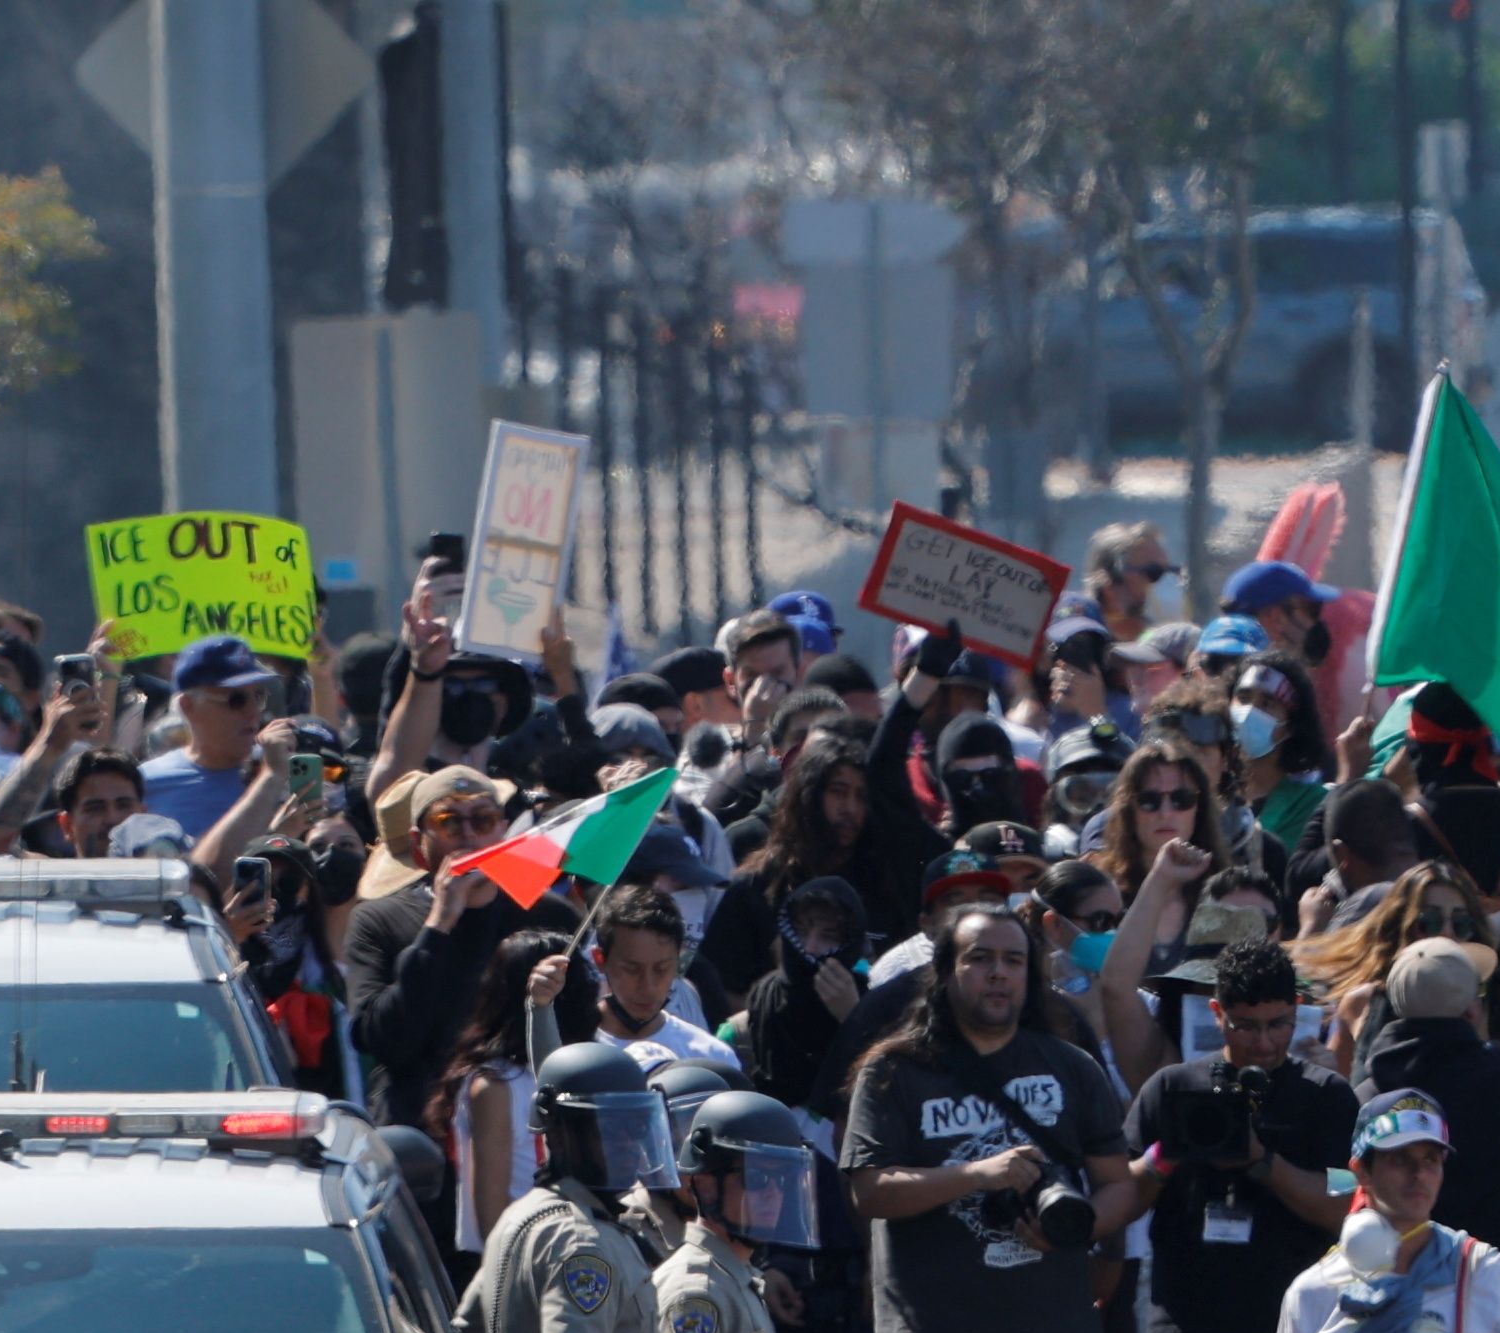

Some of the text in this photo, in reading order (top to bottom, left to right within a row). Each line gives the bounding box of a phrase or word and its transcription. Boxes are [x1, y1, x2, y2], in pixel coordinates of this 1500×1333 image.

[99, 531, 146, 569] ICE
[168, 518, 258, 565] OUT
[904, 530, 956, 561] GET
[964, 551, 998, 578] ICE
[994, 562, 1031, 589] OUT
[115, 574, 180, 619] LOS
